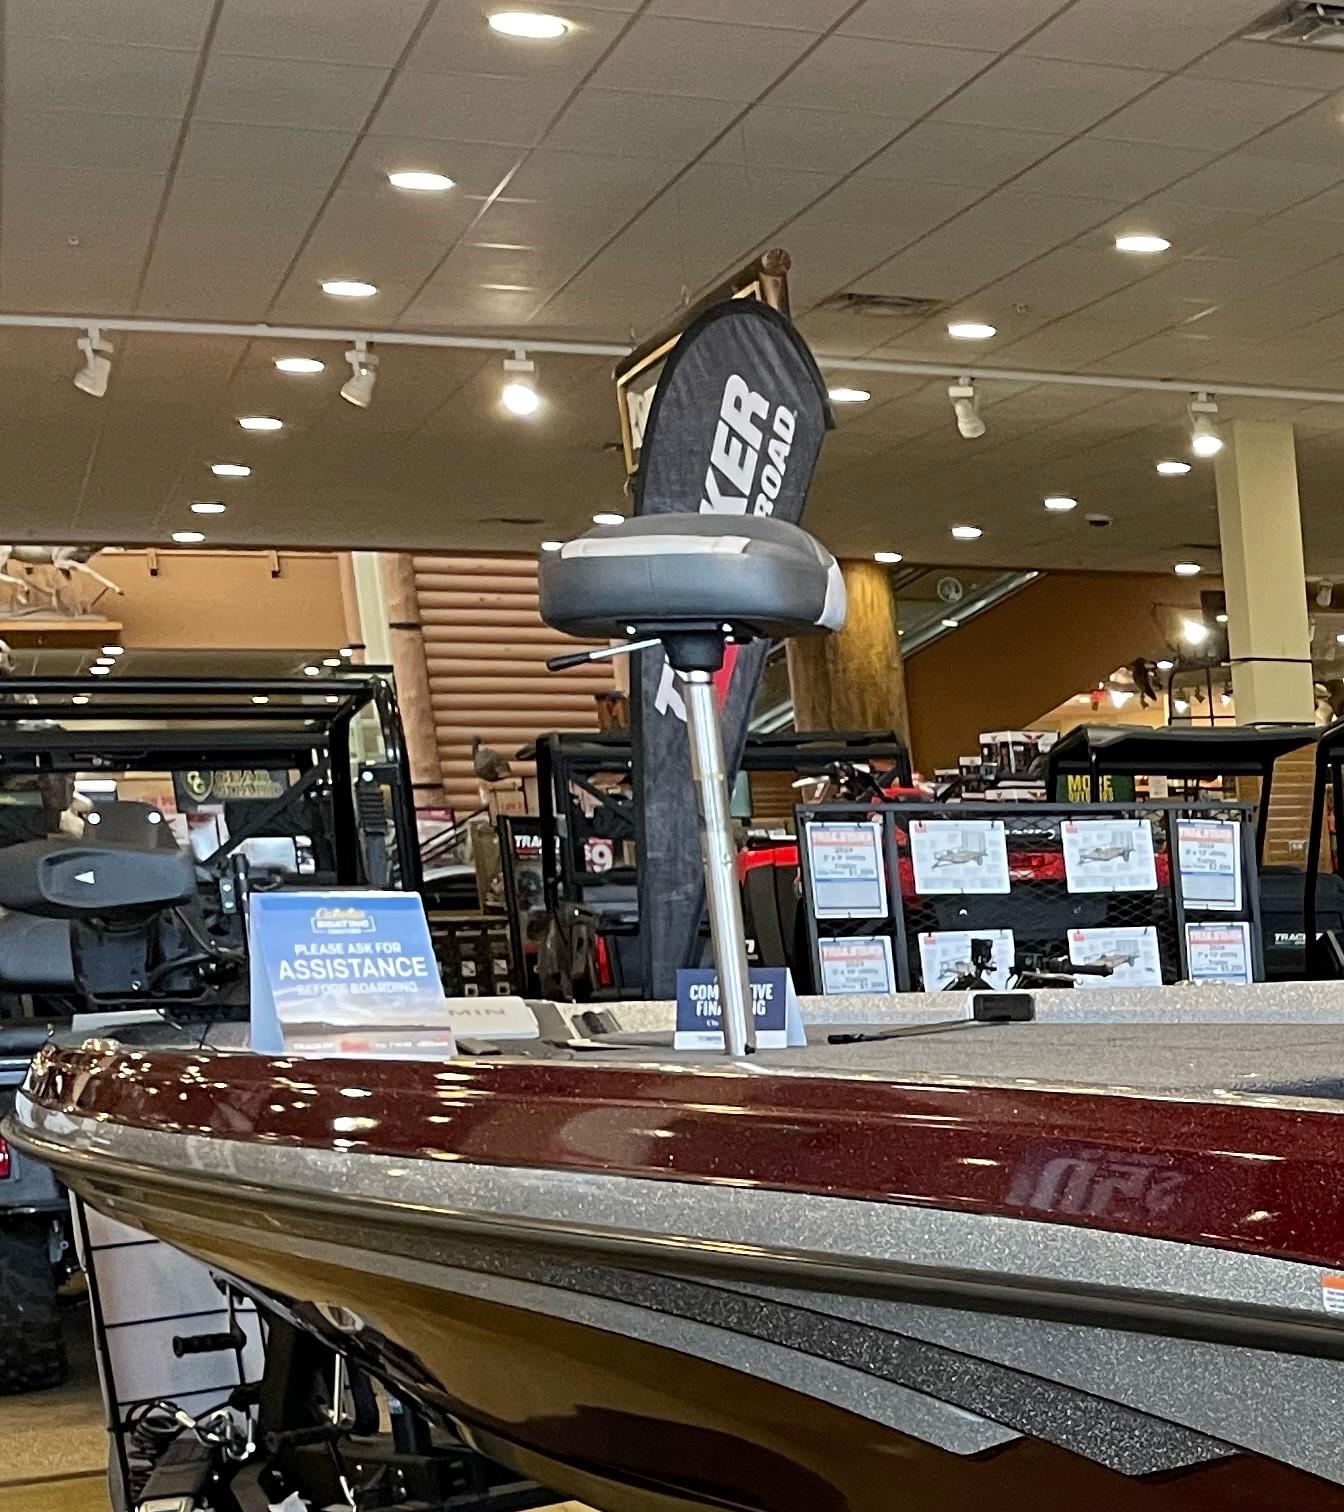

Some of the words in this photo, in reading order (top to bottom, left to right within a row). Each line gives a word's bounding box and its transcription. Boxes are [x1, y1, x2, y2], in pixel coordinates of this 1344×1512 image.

[294, 943, 345, 956] PLEASE
[348, 942, 373, 955] ASK
[375, 942, 402, 954] FOR
[279, 957, 428, 980] ASSISTANCE
[296, 983, 349, 996] BEFORE
[350, 981, 418, 994] BOARDING
